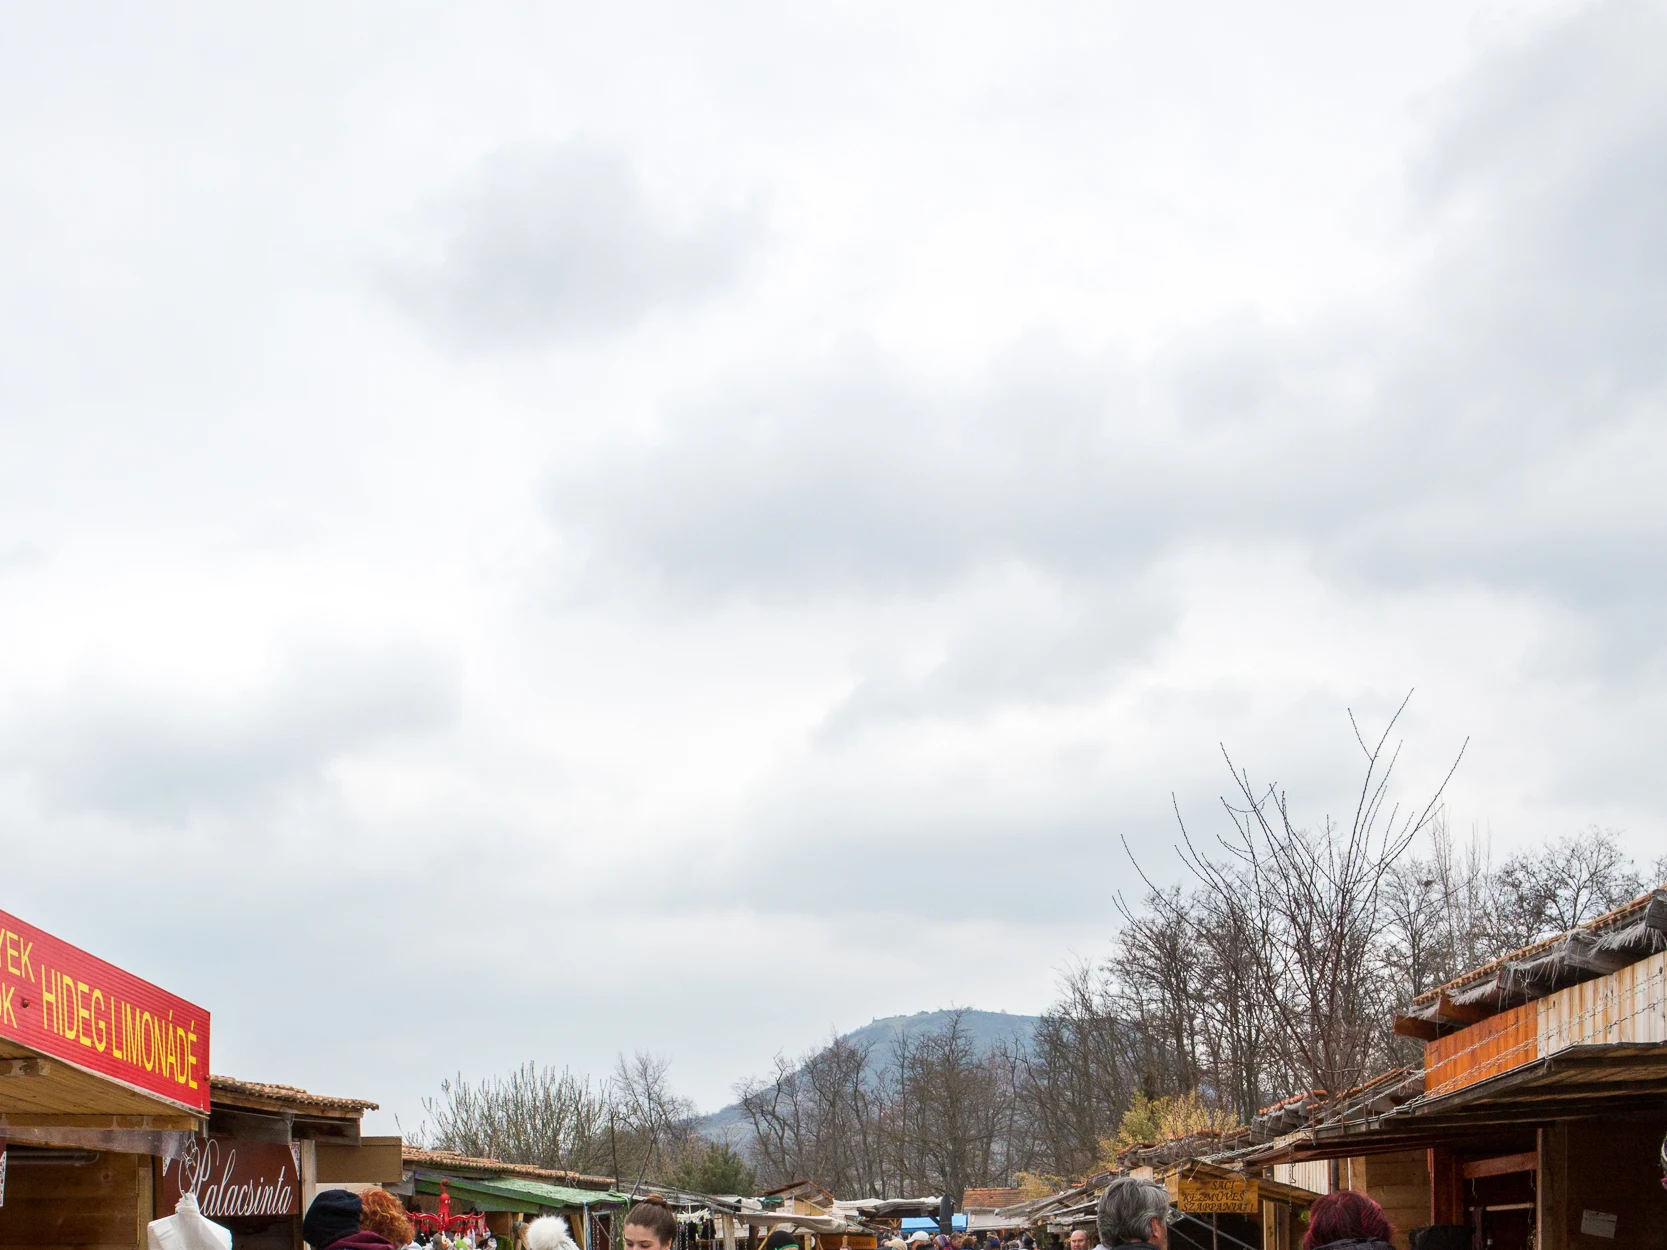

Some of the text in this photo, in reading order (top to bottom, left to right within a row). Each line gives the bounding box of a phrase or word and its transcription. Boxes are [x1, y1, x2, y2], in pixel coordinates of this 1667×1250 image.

[42, 964, 198, 1090] HIDEG LIMONÁDÉ
[179, 1139, 293, 1216] Palacsinta
[1211, 1181, 1235, 1190] SACI
